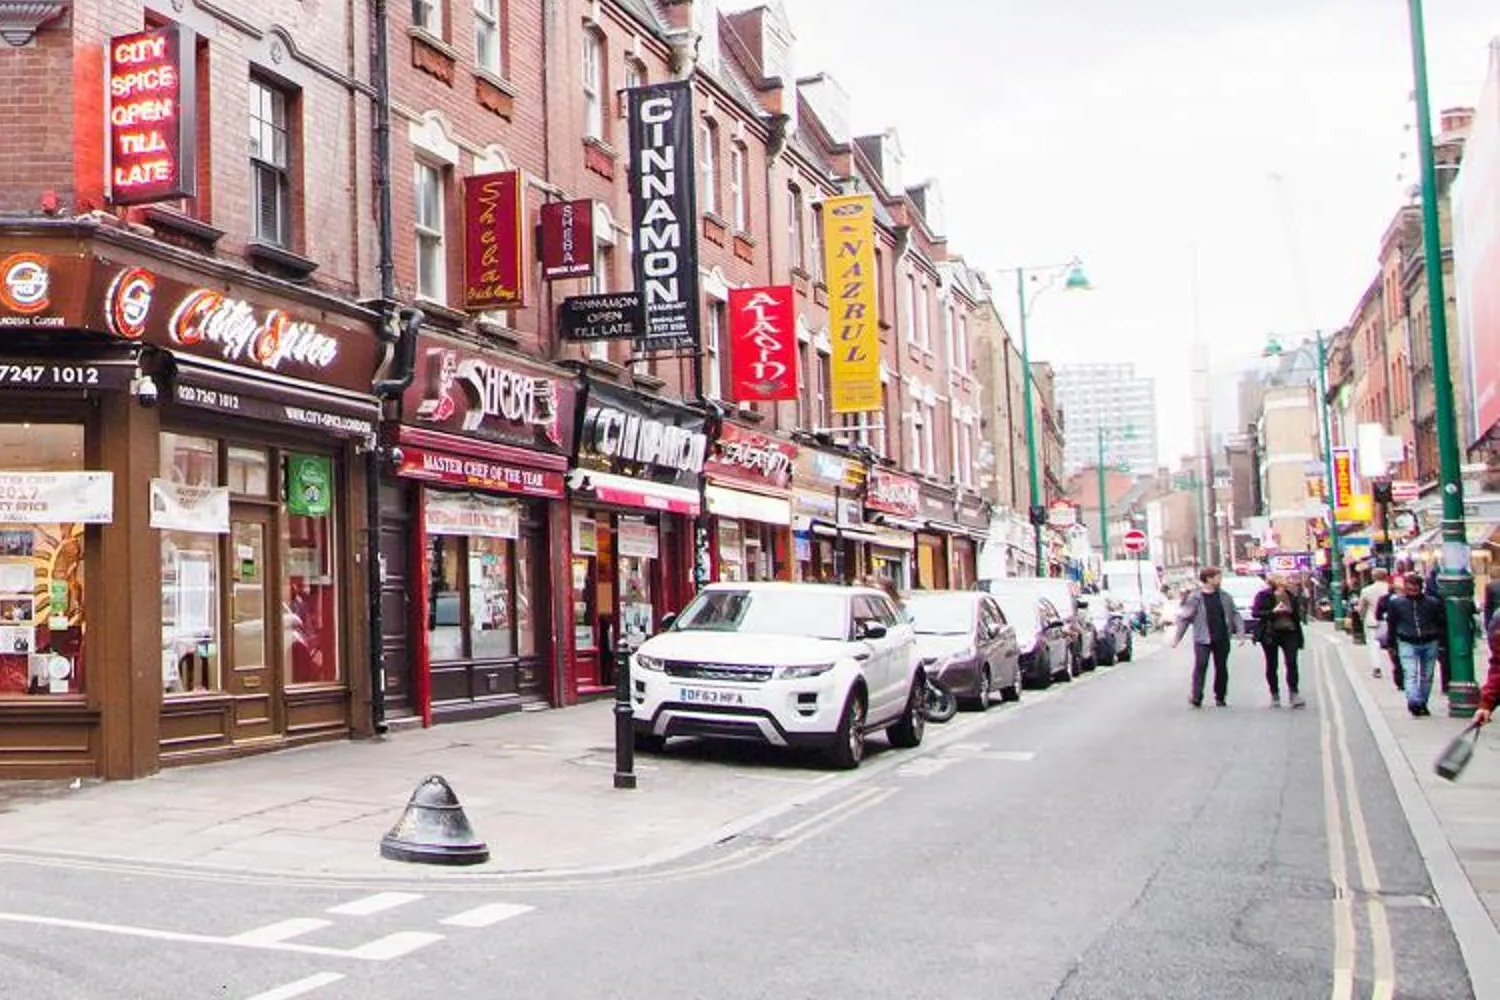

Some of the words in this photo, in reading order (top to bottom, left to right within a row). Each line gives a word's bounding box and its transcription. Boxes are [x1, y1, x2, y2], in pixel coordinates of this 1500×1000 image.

[115, 37, 165, 63] CITY
[111, 66, 173, 97] SPICE
[111, 99, 171, 126] OPEN
[120, 131, 166, 154] TILL
[115, 159, 169, 186] LATE
[639, 97, 681, 303] CINNAMON
[837, 239, 868, 362] NAZRUL
[169, 289, 257, 359] City
[249, 309, 337, 370] Spice
[574, 326, 599, 337] TILL
[601, 322, 633, 336] LATE
[587, 311, 623, 323] OPEN
[52, 366, 98, 385] 1012
[219, 393, 239, 409] 1012
[456, 359, 536, 430] SHEBA
[423, 453, 462, 475] MASTER
[464, 461, 489, 479] CHEF
[490, 465, 502, 481] OF
[504, 468, 521, 484] THE
[522, 472, 543, 486] YEAR
[16, 501, 48, 511] SPICE
